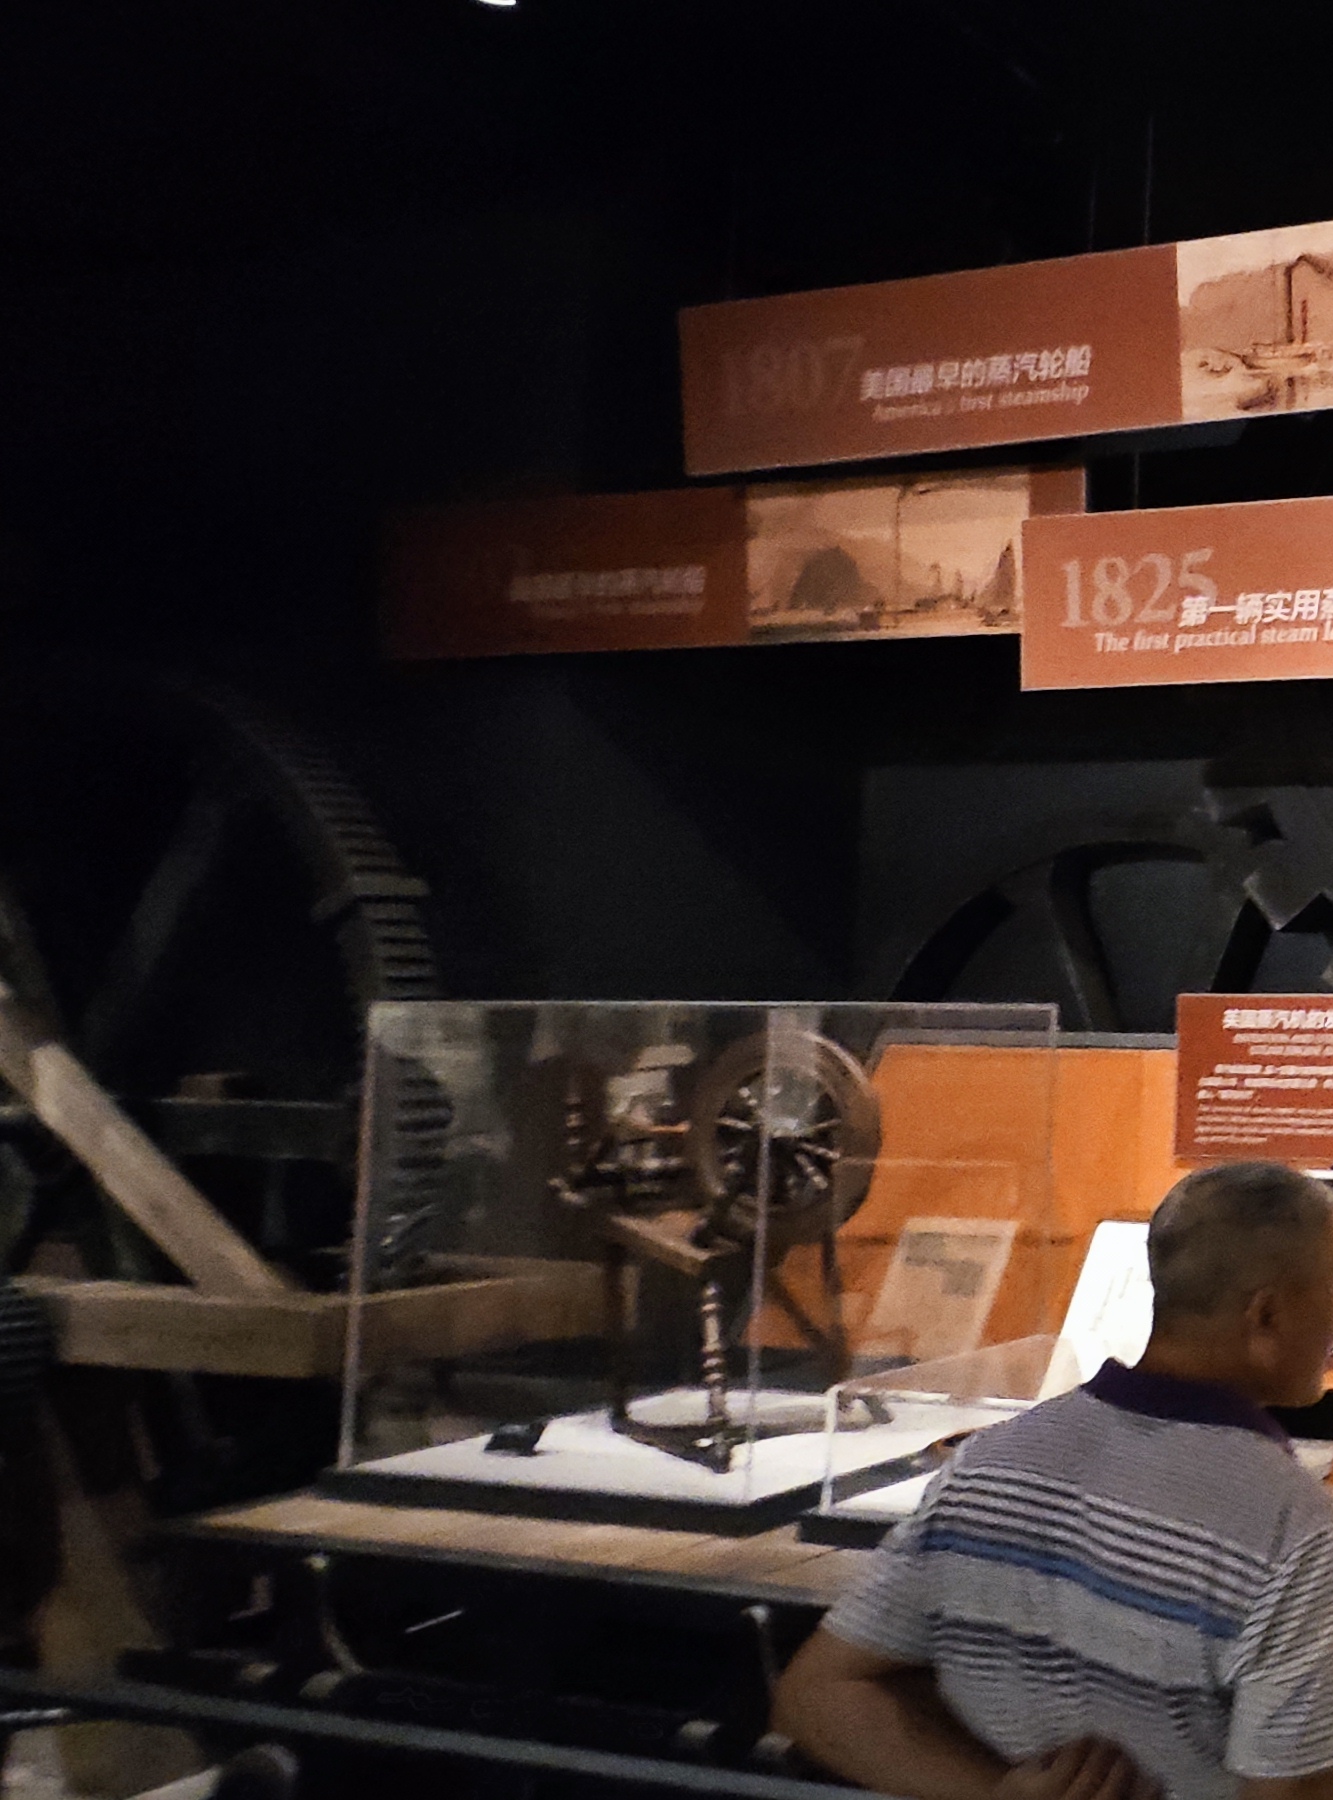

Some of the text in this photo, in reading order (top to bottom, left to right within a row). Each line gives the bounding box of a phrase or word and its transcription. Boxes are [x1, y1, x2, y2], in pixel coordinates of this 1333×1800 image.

[860, 344, 1092, 401] 美国最早的蒸汽轮船
[1060, 547, 1218, 628] 1825
[1095, 631, 1128, 653] The
[1133, 631, 1169, 652] first
[1173, 622, 1256, 654] practical
[1260, 625, 1318, 644] steam
